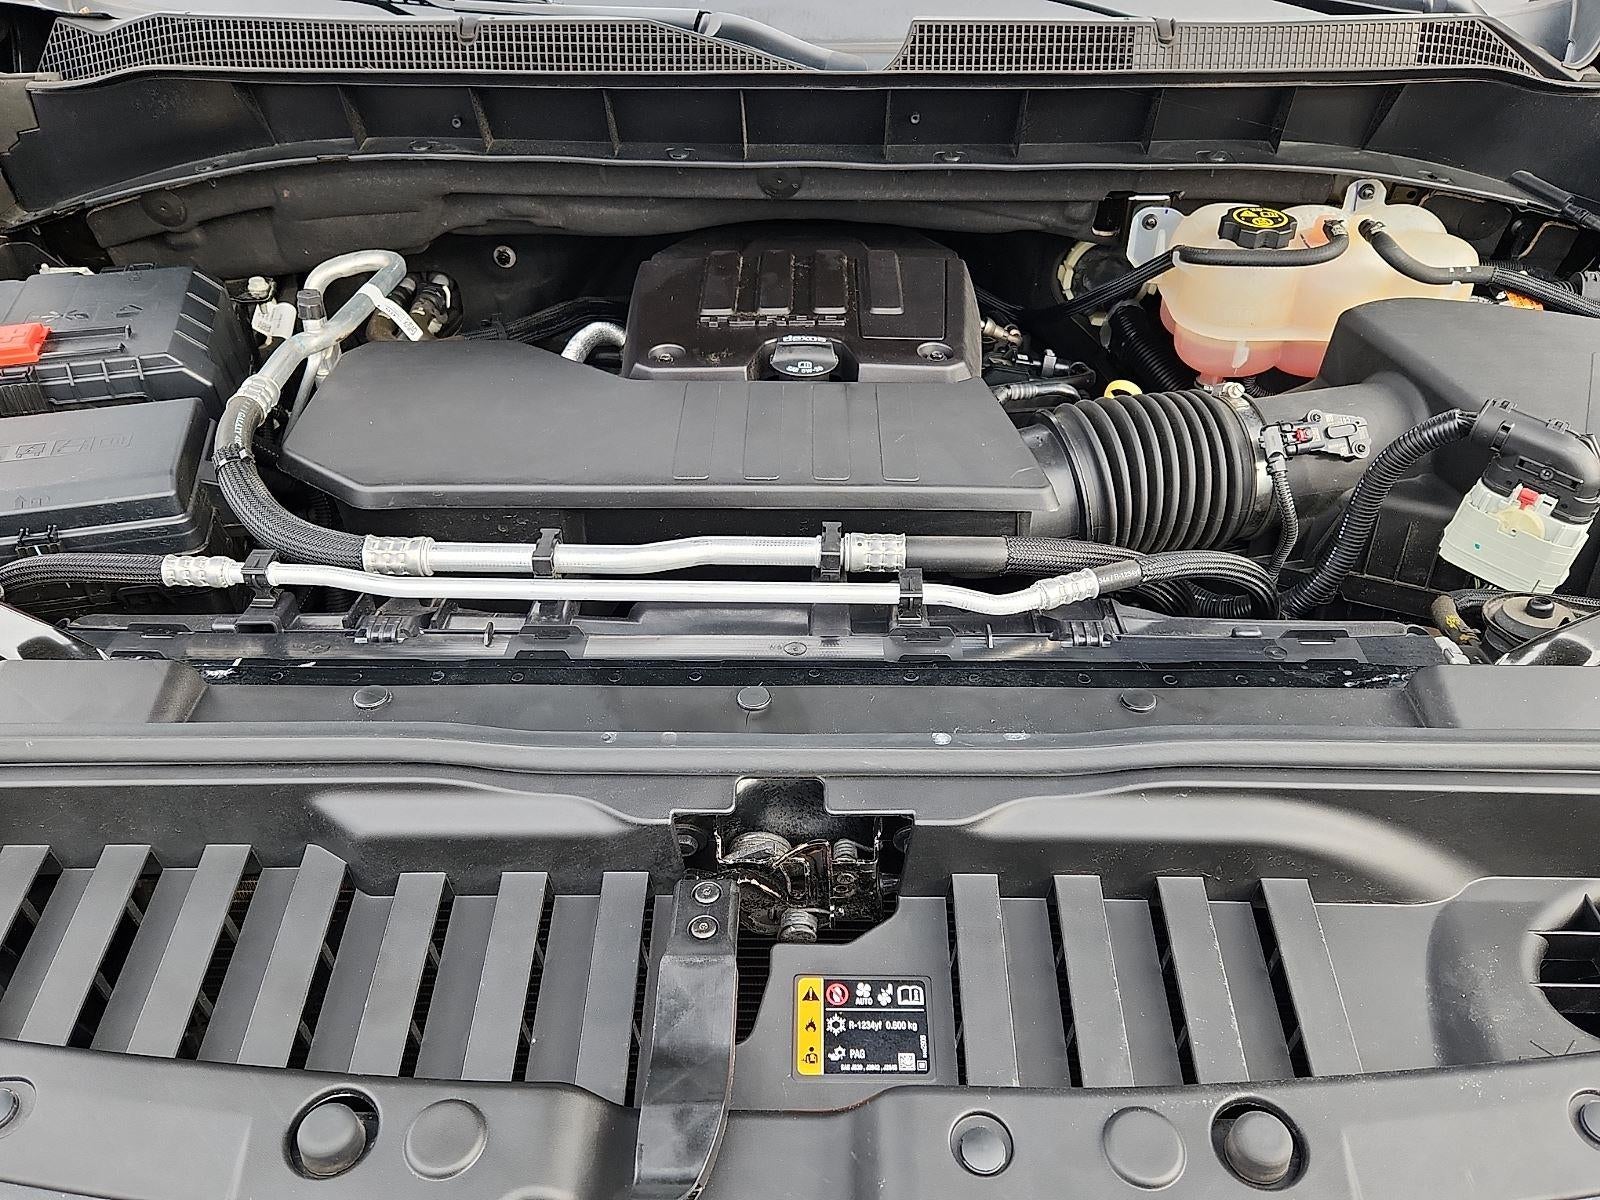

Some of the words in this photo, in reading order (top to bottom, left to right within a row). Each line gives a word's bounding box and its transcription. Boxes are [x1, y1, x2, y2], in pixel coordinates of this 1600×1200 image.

[782, 335, 827, 343] dexos
[855, 997, 873, 1006] AUTO
[848, 1020, 883, 1032] R-1234yf
[907, 1020, 918, 1032] kg
[849, 1048, 866, 1059] PAG
